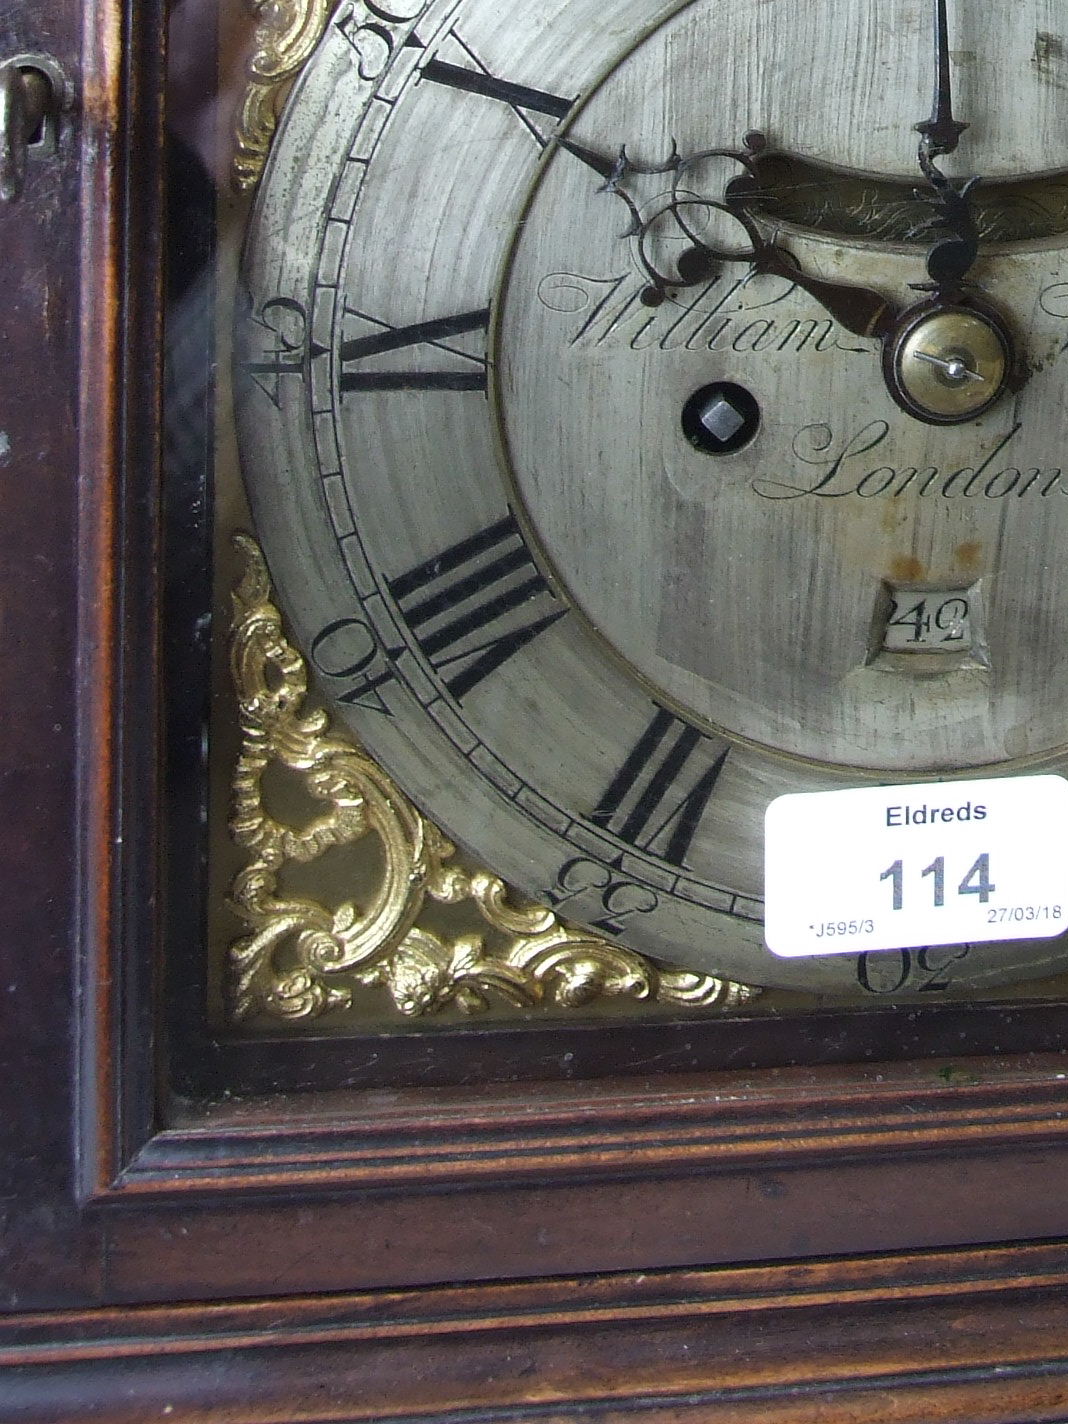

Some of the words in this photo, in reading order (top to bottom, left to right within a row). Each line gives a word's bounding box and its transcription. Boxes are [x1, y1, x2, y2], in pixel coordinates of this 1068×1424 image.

[415, 16, 581, 158] X
[248, 295, 307, 410] 45
[337, 297, 493, 406] IX
[538, 266, 870, 353] William
[380, 503, 572, 708] VIII
[310, 617, 396, 717] 40
[578, 701, 734, 872] VII
[886, 801, 988, 827] Eldreds
[541, 854, 660, 937] 35
[879, 852, 996, 911] 114
[986, 904, 1063, 924] 27/03/18
